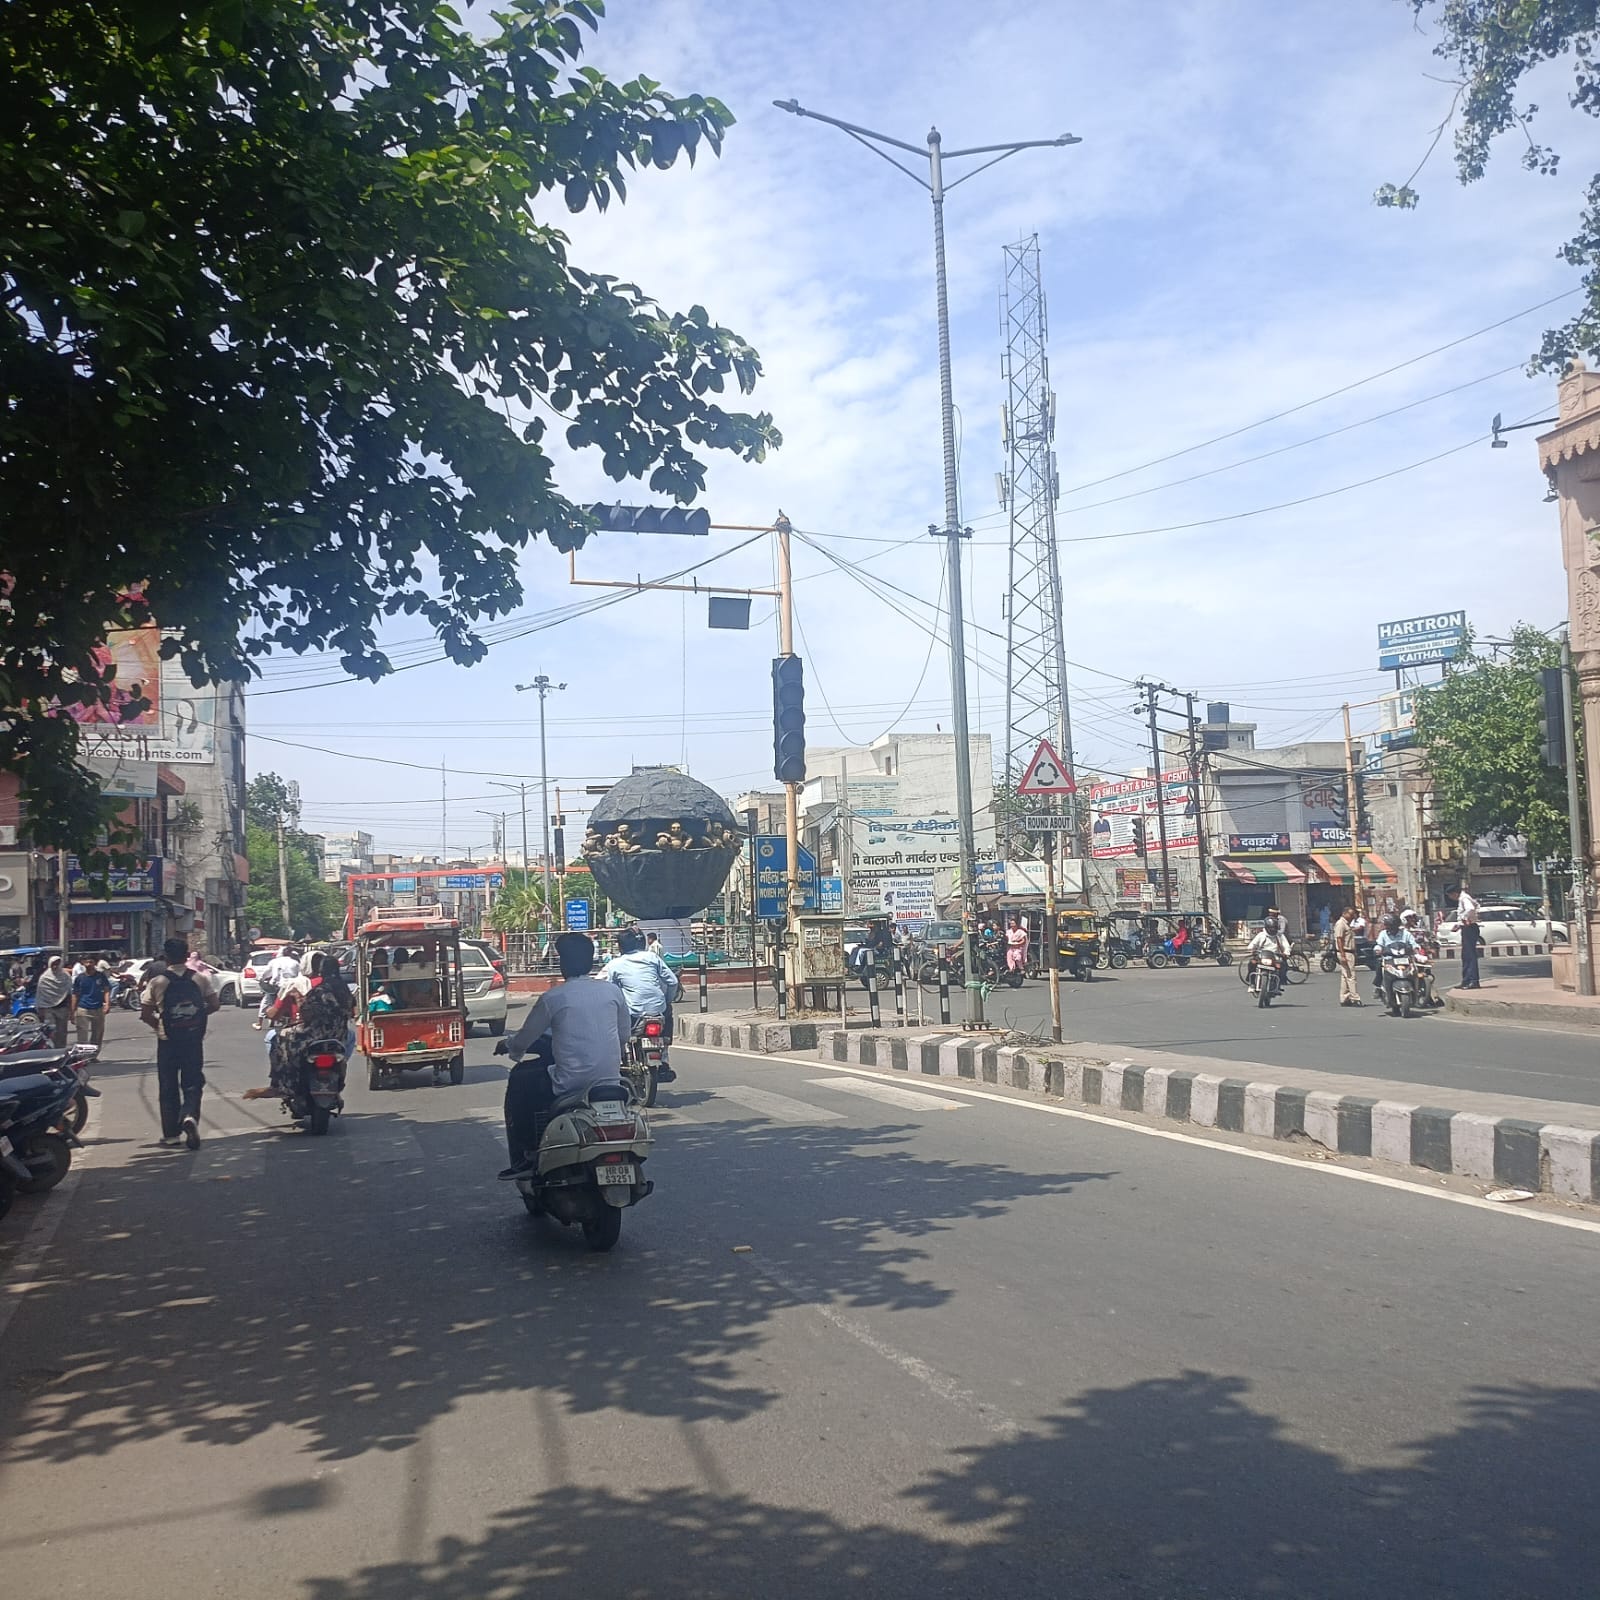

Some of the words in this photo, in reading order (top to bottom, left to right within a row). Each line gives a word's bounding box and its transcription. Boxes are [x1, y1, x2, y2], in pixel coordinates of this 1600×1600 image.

[1380, 613, 1461, 637] HARTRON
[1399, 649, 1444, 662] KAITHAL
[1102, 785, 1120, 797] SMILE
[1121, 782, 1134, 792] ENT
[1028, 817, 1048, 829] ROUND
[1050, 816, 1070, 829] ABOUT
[606, 1166, 617, 1174] HR
